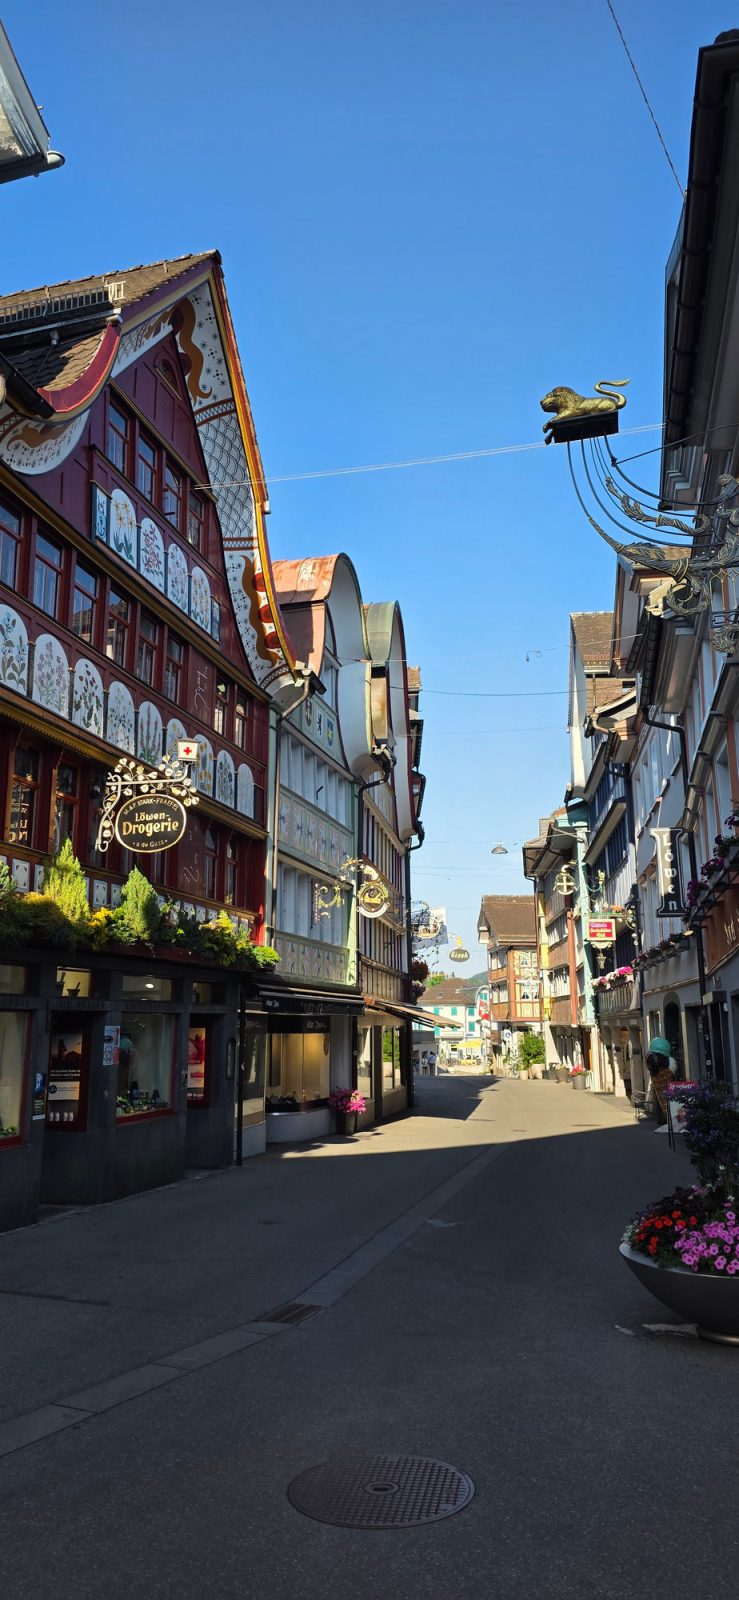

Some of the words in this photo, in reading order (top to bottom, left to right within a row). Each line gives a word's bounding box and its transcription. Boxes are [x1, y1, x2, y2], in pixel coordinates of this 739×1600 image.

[121, 817, 179, 837] Drogerie
[134, 812, 170, 822] Löwen-
[663, 835, 677, 911] Löwen
